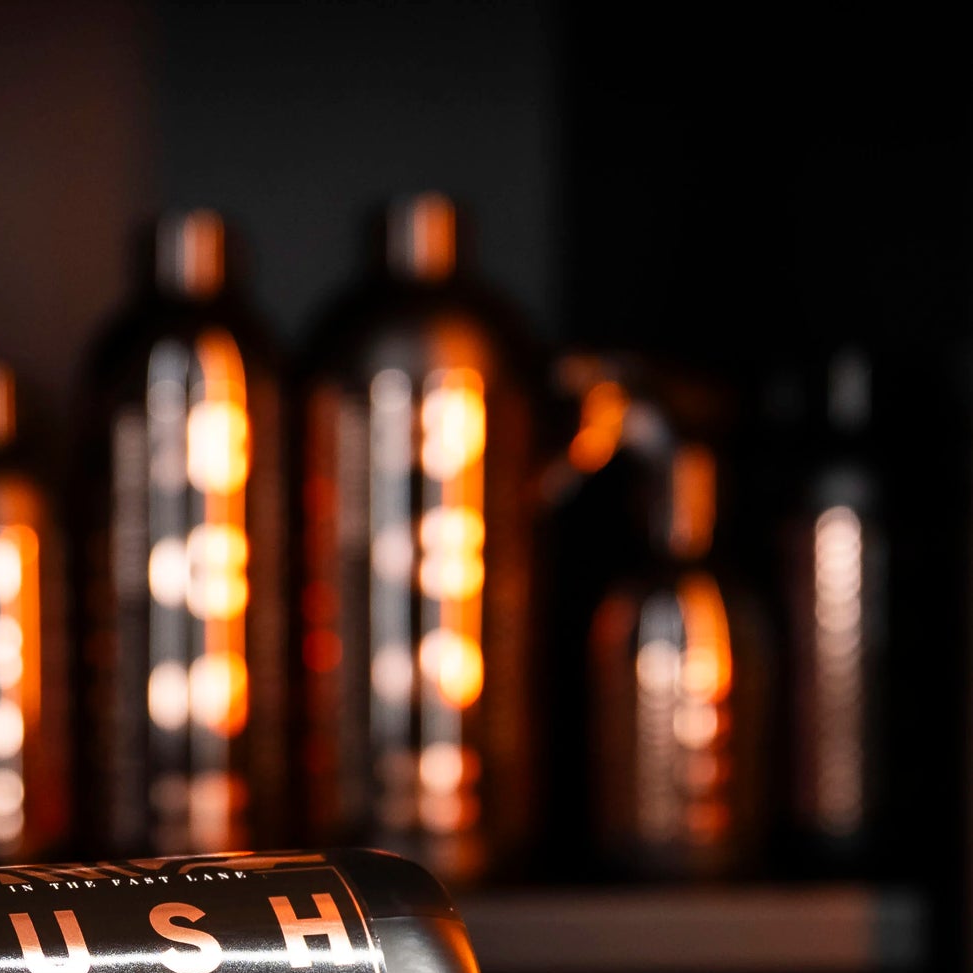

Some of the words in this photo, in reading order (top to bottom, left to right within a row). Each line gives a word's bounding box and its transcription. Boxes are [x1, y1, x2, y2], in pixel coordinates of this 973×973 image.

[9, 884, 34, 893] IN
[49, 880, 97, 891] THE
[112, 875, 169, 887] FAST
[186, 871, 247, 882] LANE
